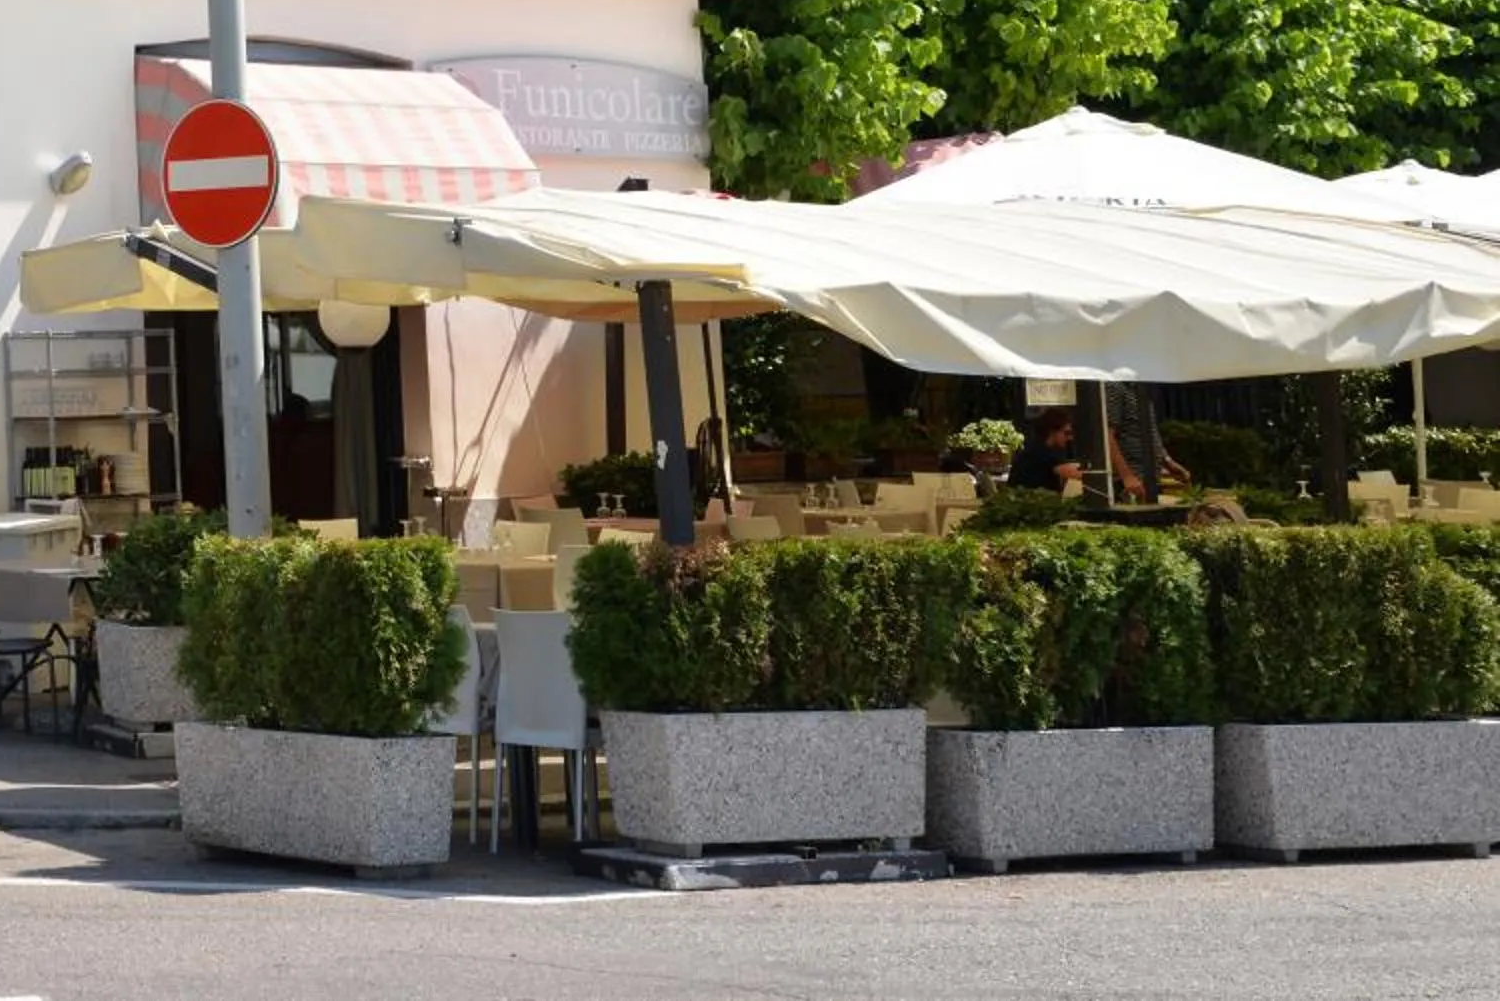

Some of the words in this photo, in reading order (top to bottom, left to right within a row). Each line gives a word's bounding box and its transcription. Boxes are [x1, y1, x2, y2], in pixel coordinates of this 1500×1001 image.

[491, 68, 702, 126] Funicolare
[516, 125, 612, 150] STORANTE
[624, 131, 704, 152] PIZZERIA
